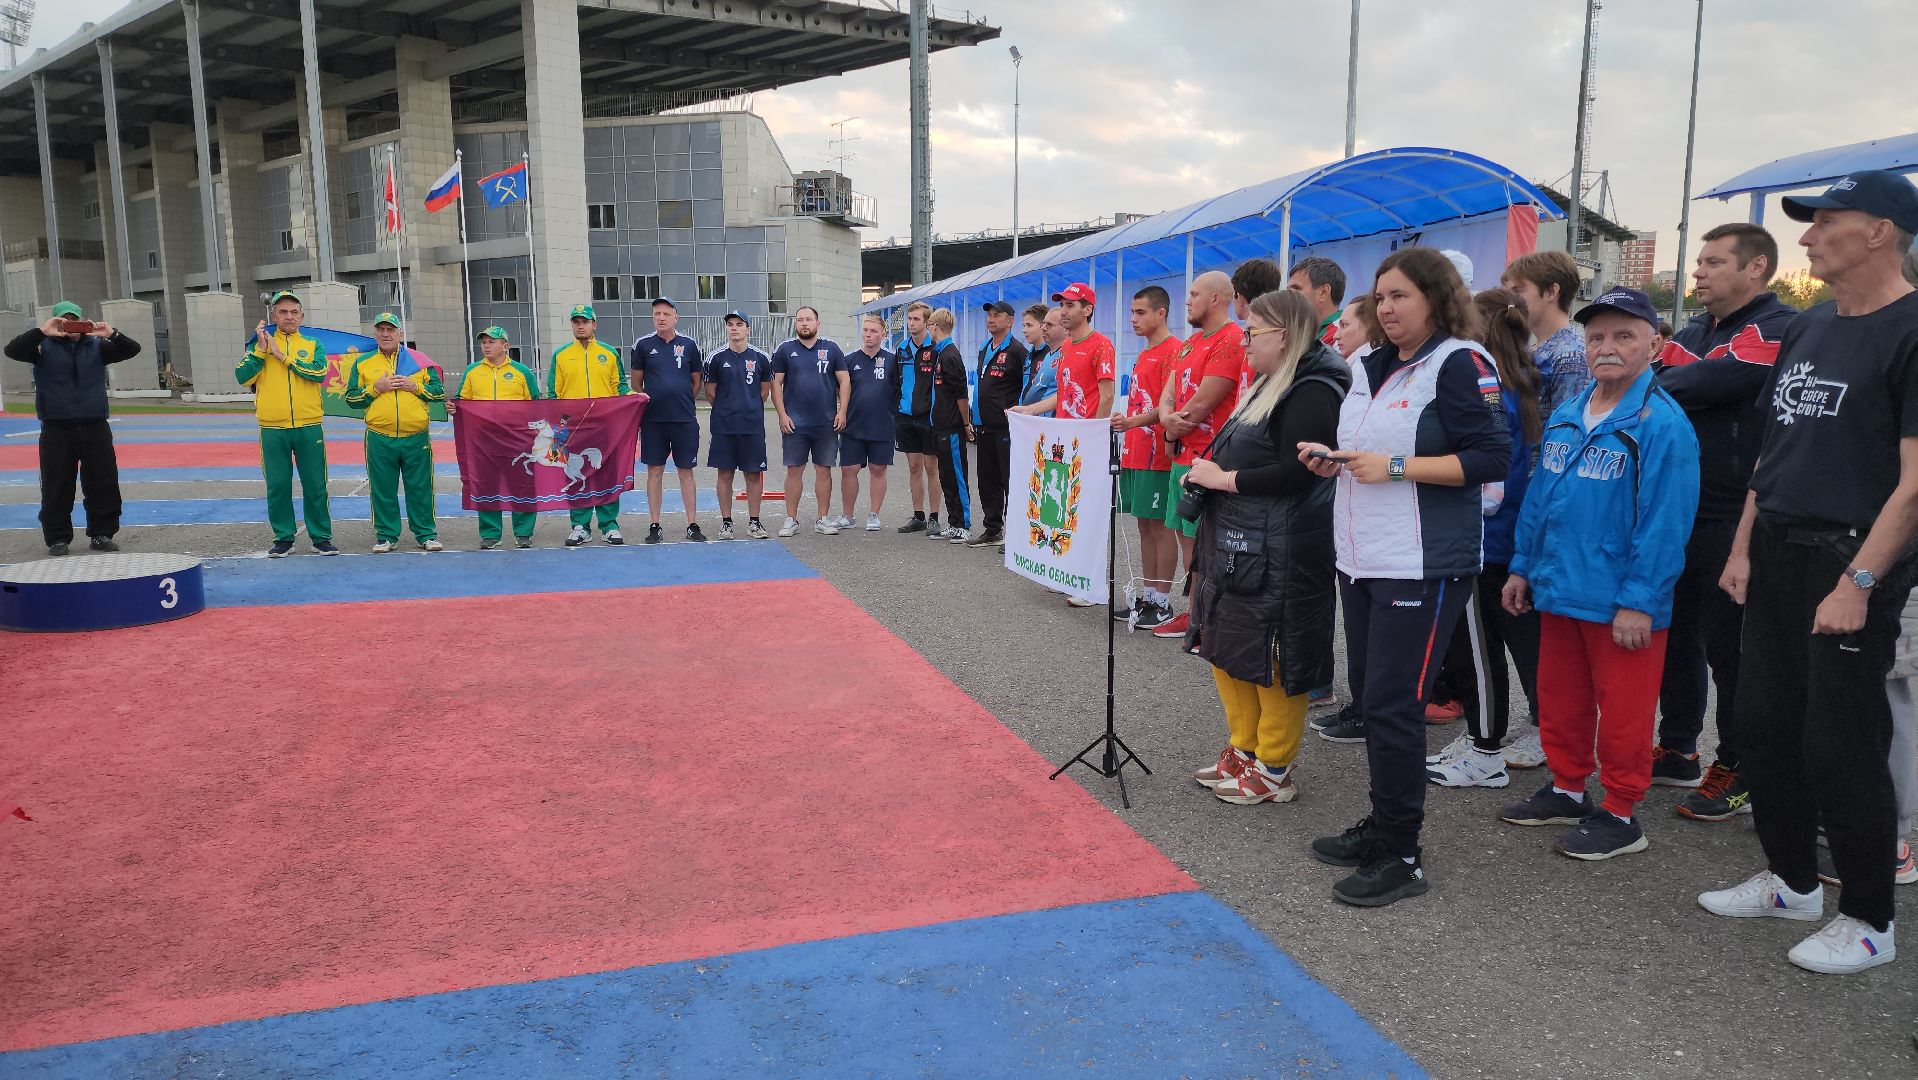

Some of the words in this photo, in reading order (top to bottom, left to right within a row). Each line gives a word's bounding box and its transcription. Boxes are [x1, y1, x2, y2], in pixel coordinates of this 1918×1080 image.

[675, 356, 682, 369] 1
[816, 360, 829, 374] 17
[745, 371, 754, 385] 5
[1151, 492, 1160, 509] 2
[158, 577, 178, 609] 3
